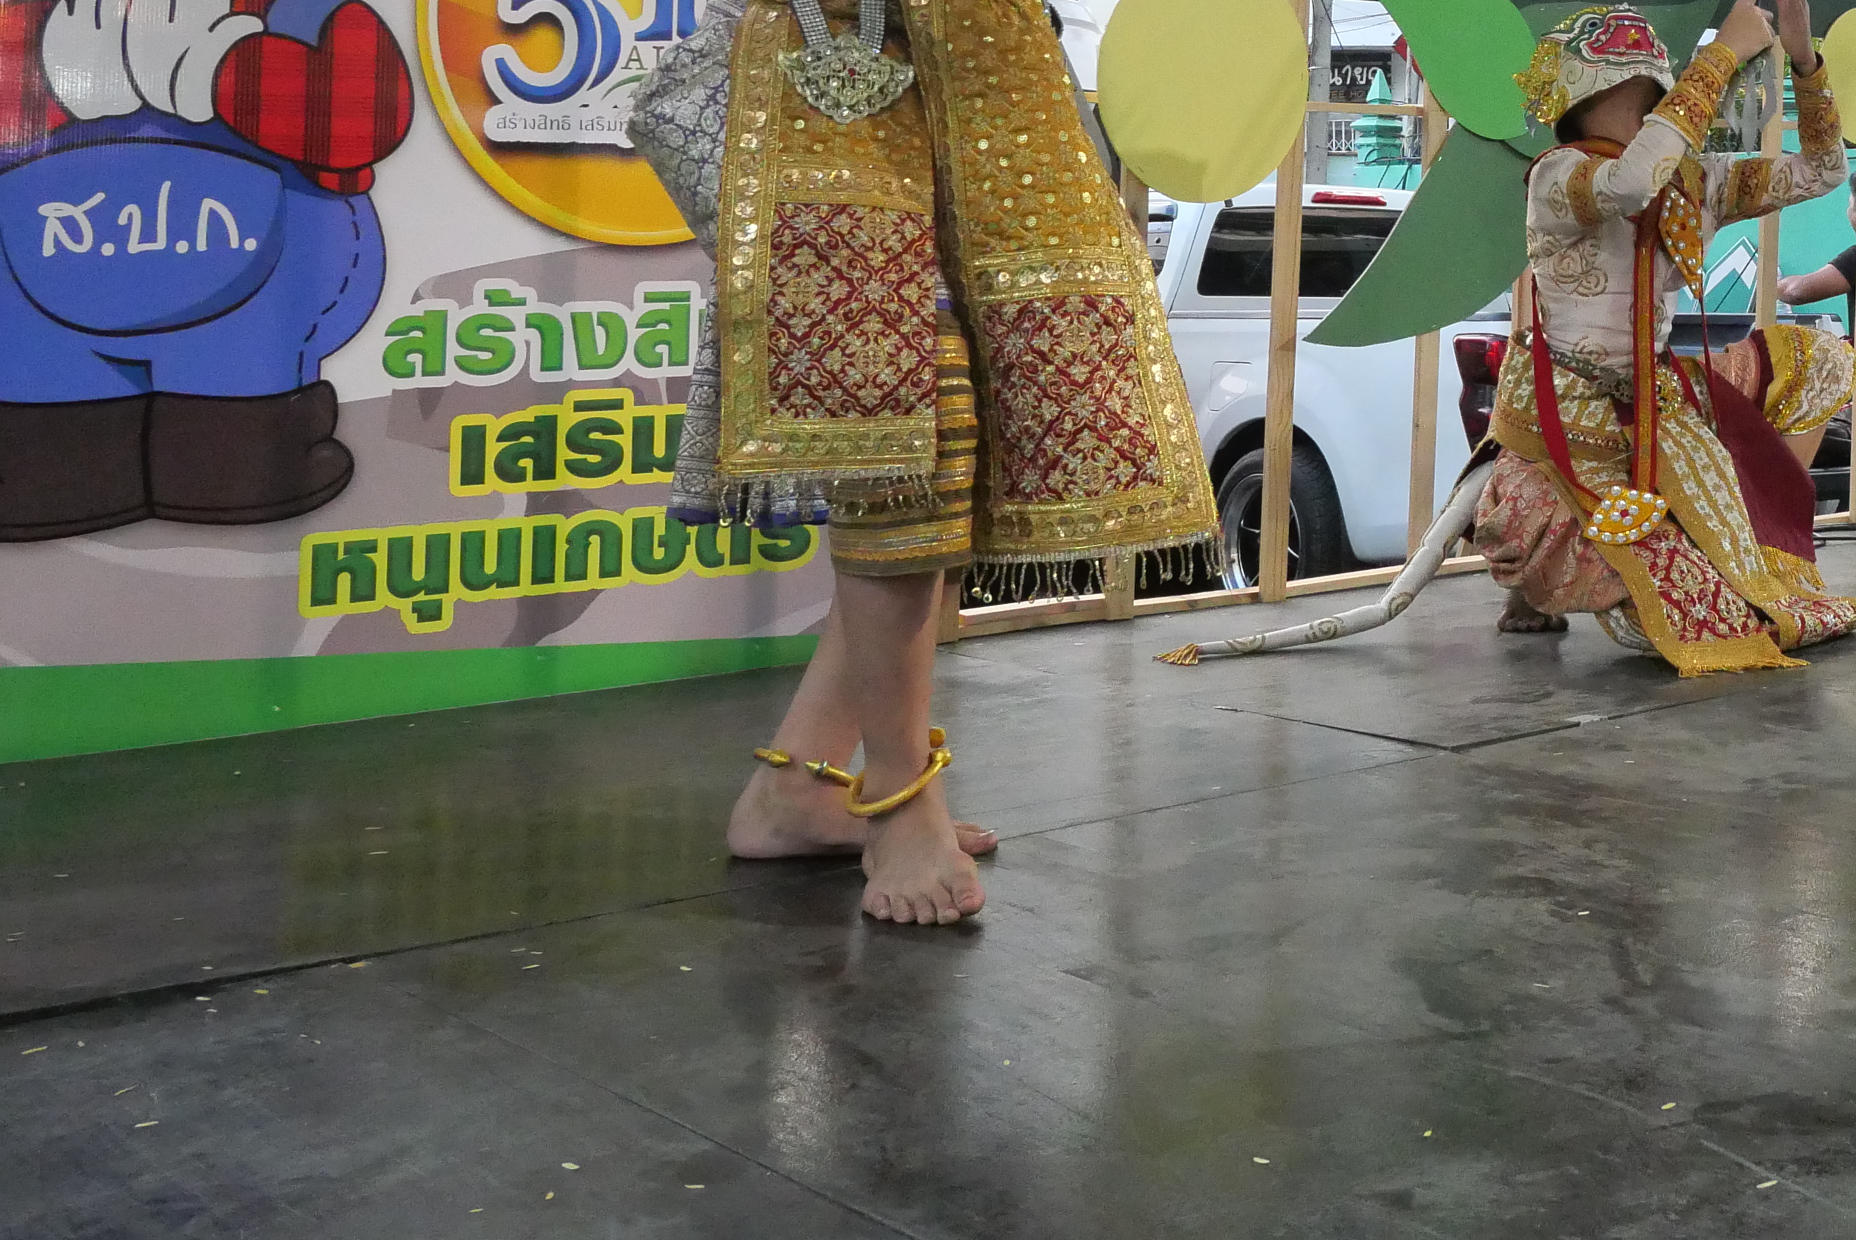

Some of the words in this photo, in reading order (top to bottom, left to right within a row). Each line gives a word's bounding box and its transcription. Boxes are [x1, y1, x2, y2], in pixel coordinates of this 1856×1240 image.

[495, 111, 572, 132] สร้างสิทธิ
[38, 180, 258, 257] ส.ป.ก.
[381, 288, 706, 379] สร้างสิ
